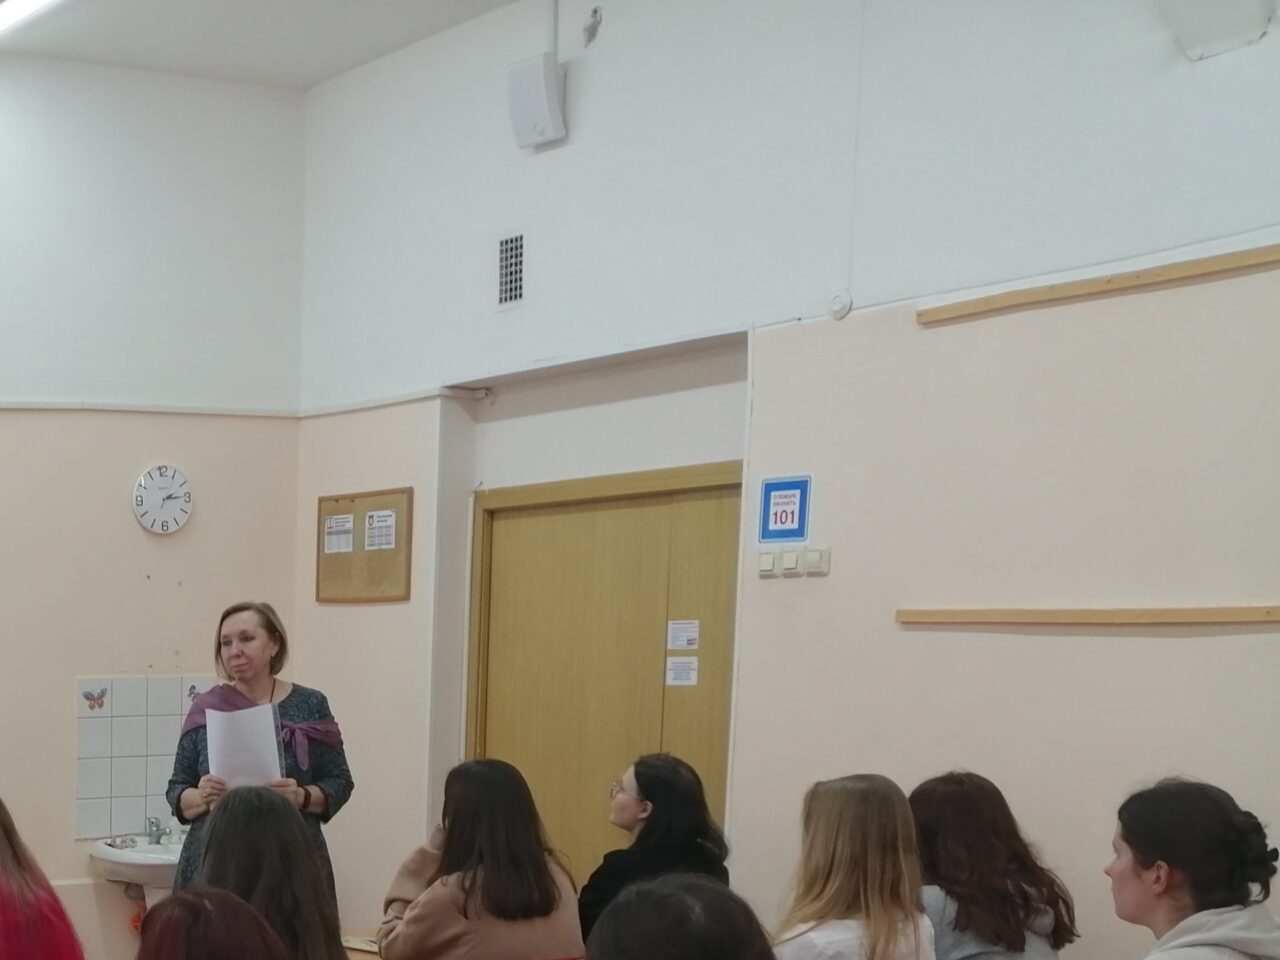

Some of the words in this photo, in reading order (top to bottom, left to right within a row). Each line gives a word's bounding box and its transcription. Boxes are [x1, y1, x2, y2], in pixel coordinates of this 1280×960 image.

[157, 465, 168, 478] 12
[136, 495, 144, 506] 9
[184, 492, 192, 504] 3
[773, 509, 795, 525] 101
[161, 520, 169, 532] 6
